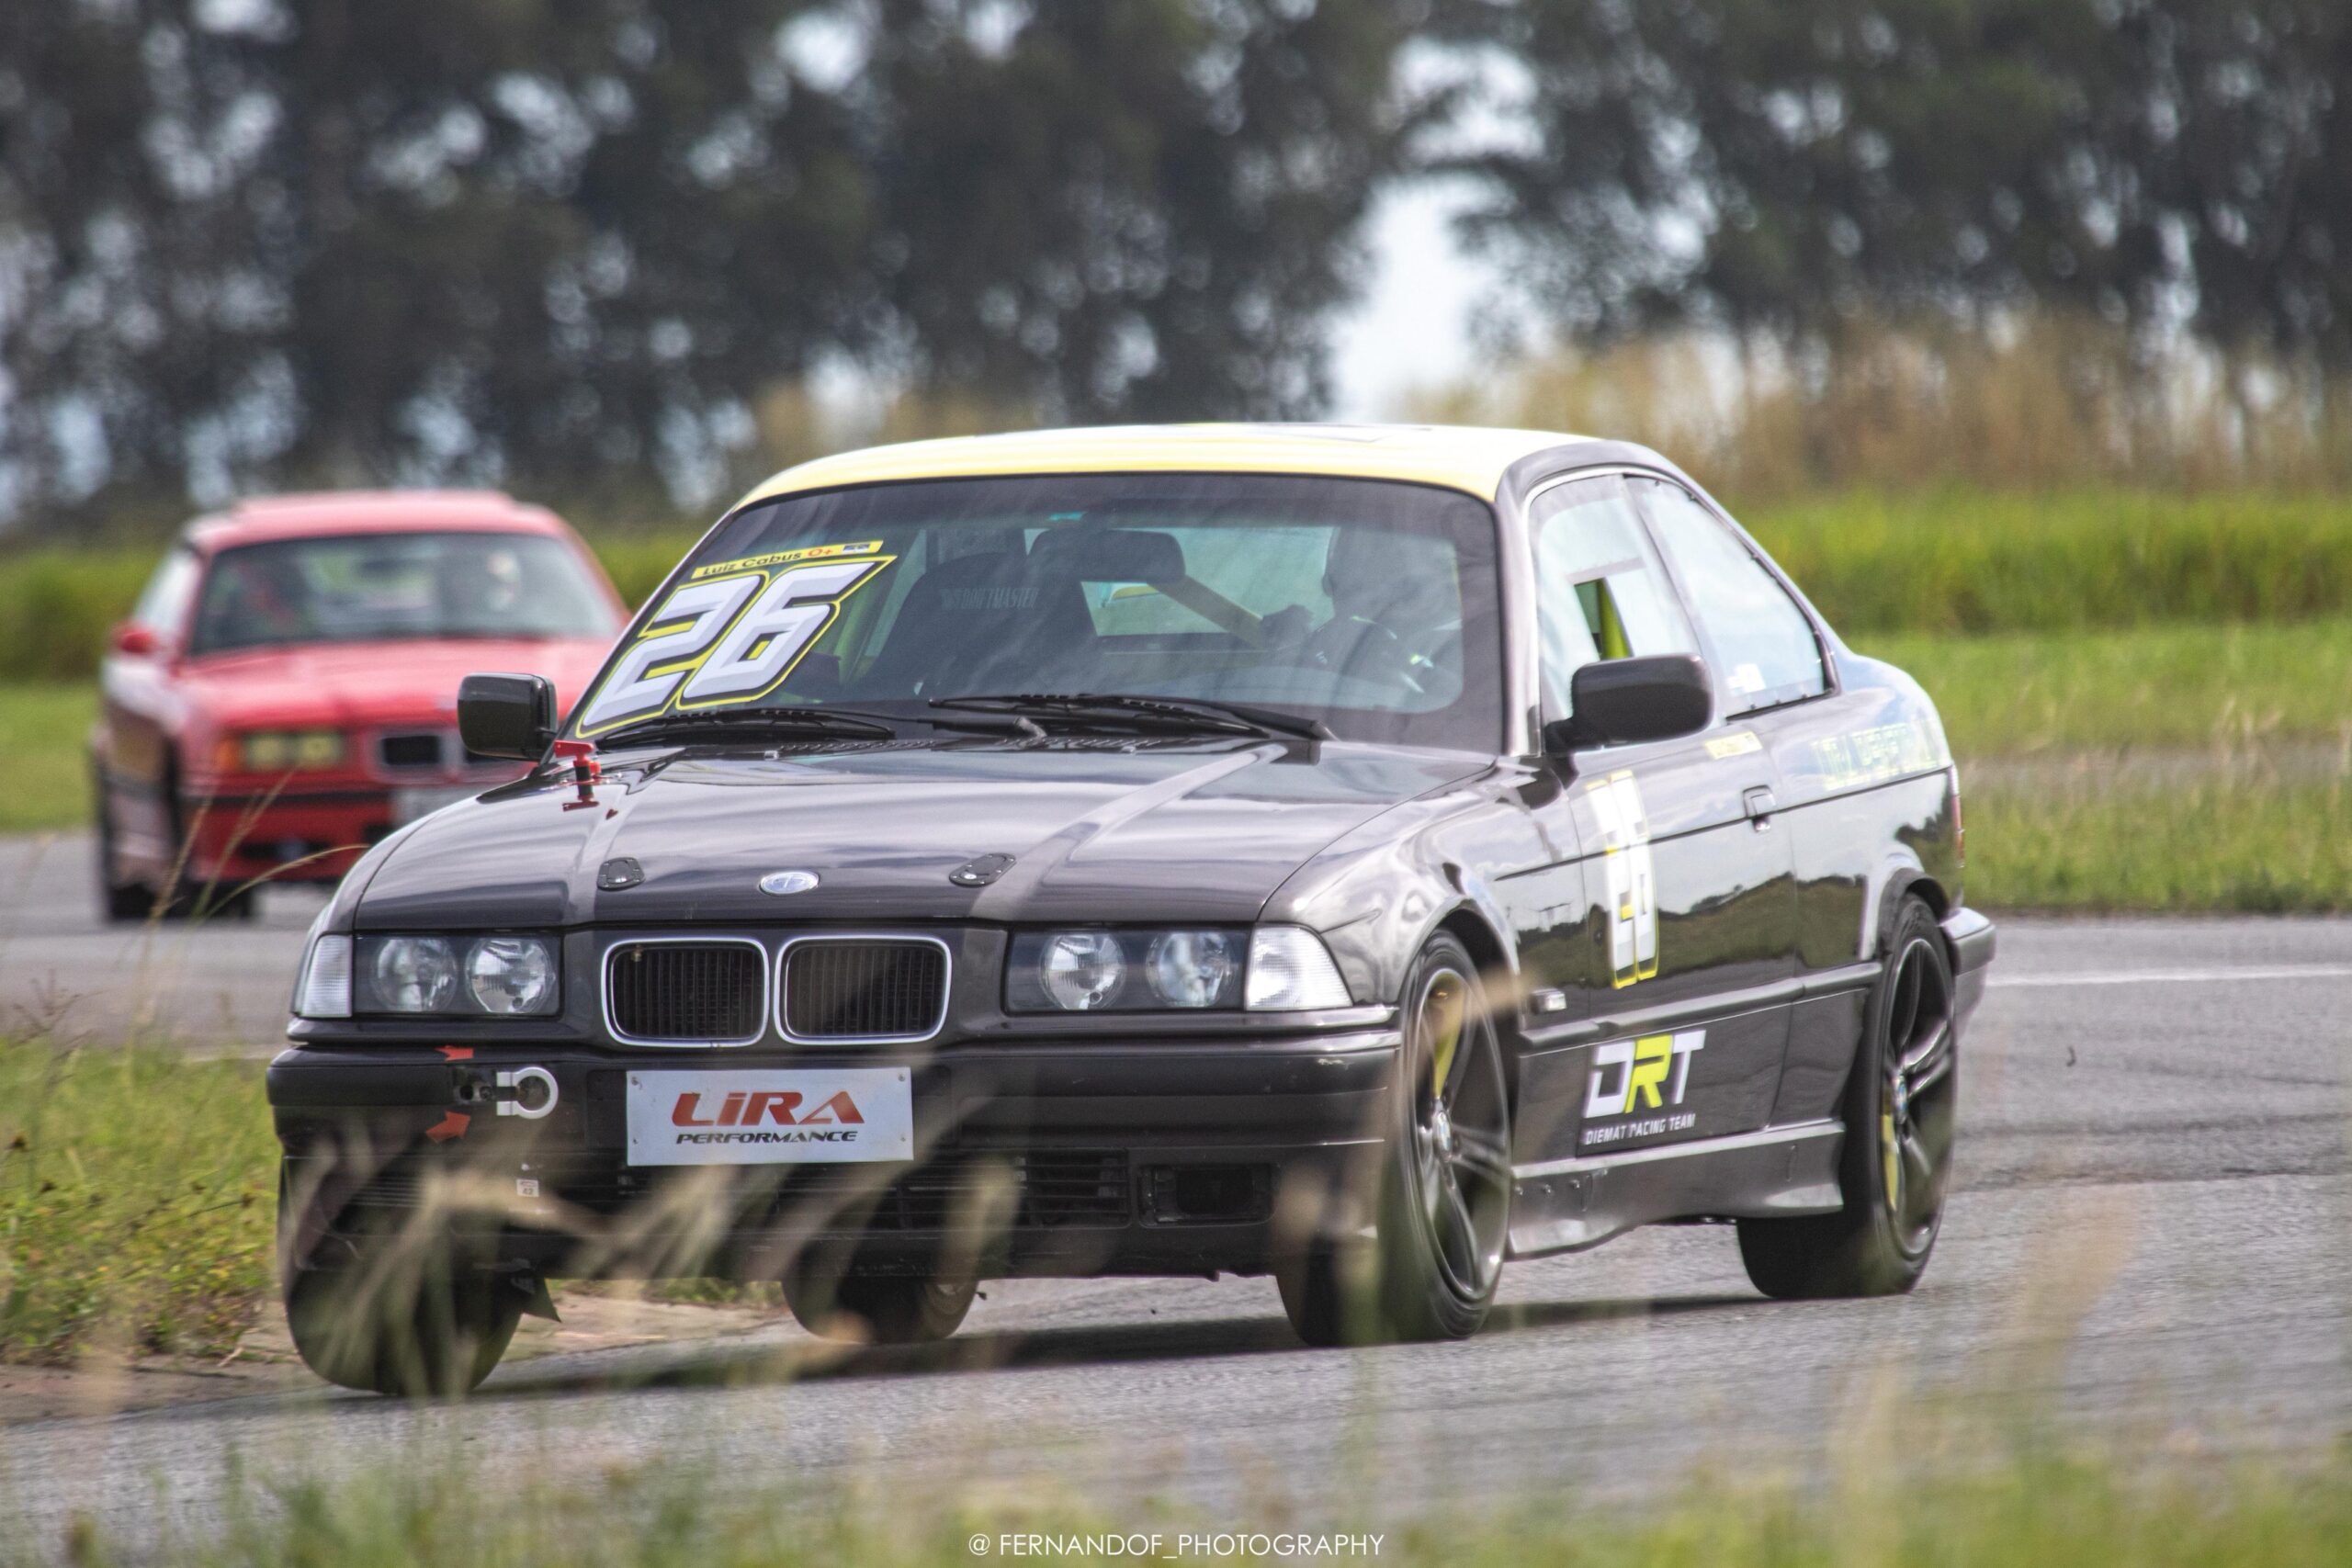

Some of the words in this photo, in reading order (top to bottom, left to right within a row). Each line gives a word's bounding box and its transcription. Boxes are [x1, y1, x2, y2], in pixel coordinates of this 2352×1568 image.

[703, 563, 735, 575] Luiz
[742, 552, 802, 568] Cabus
[581, 561, 878, 728] 26
[1584, 1030, 1706, 1118] DRT
[675, 1130, 859, 1145] PERFORMANCE
[1585, 1125, 1627, 1145] DIEMAT
[1668, 1113, 1696, 1131] TEAM
